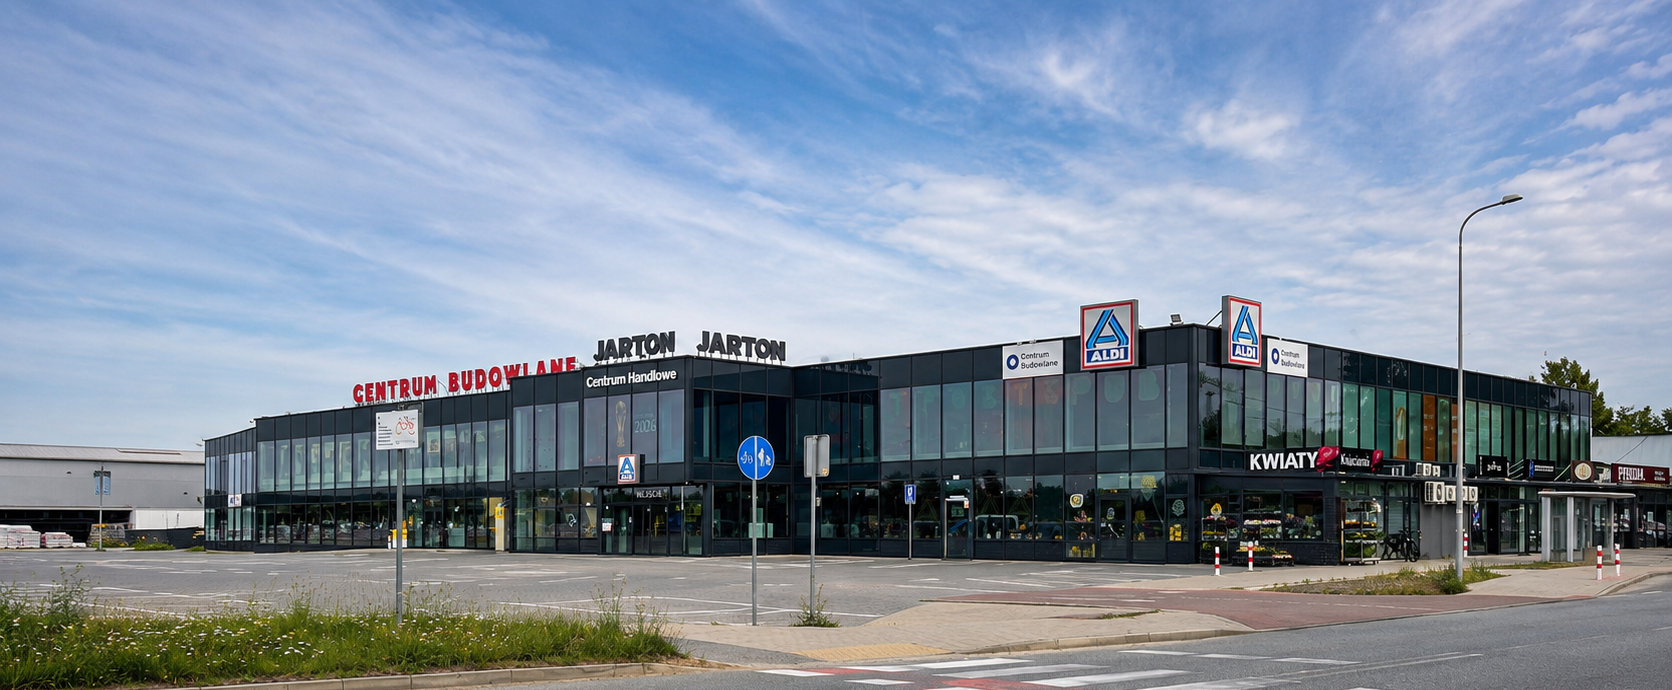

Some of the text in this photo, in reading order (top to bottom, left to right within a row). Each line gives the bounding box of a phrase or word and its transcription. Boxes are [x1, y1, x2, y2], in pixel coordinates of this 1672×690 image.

[593, 331, 676, 362] JARTON
[696, 331, 786, 361] JARTON
[1090, 347, 1125, 362] ALDI
[1234, 345, 1257, 359] ALDI
[1020, 352, 1050, 360] Centrum
[586, 369, 677, 388] Centrum Handlowe
[353, 375, 437, 403] CENTRUM
[634, 419, 657, 433] 2026
[1250, 451, 1318, 471] KWIATY
